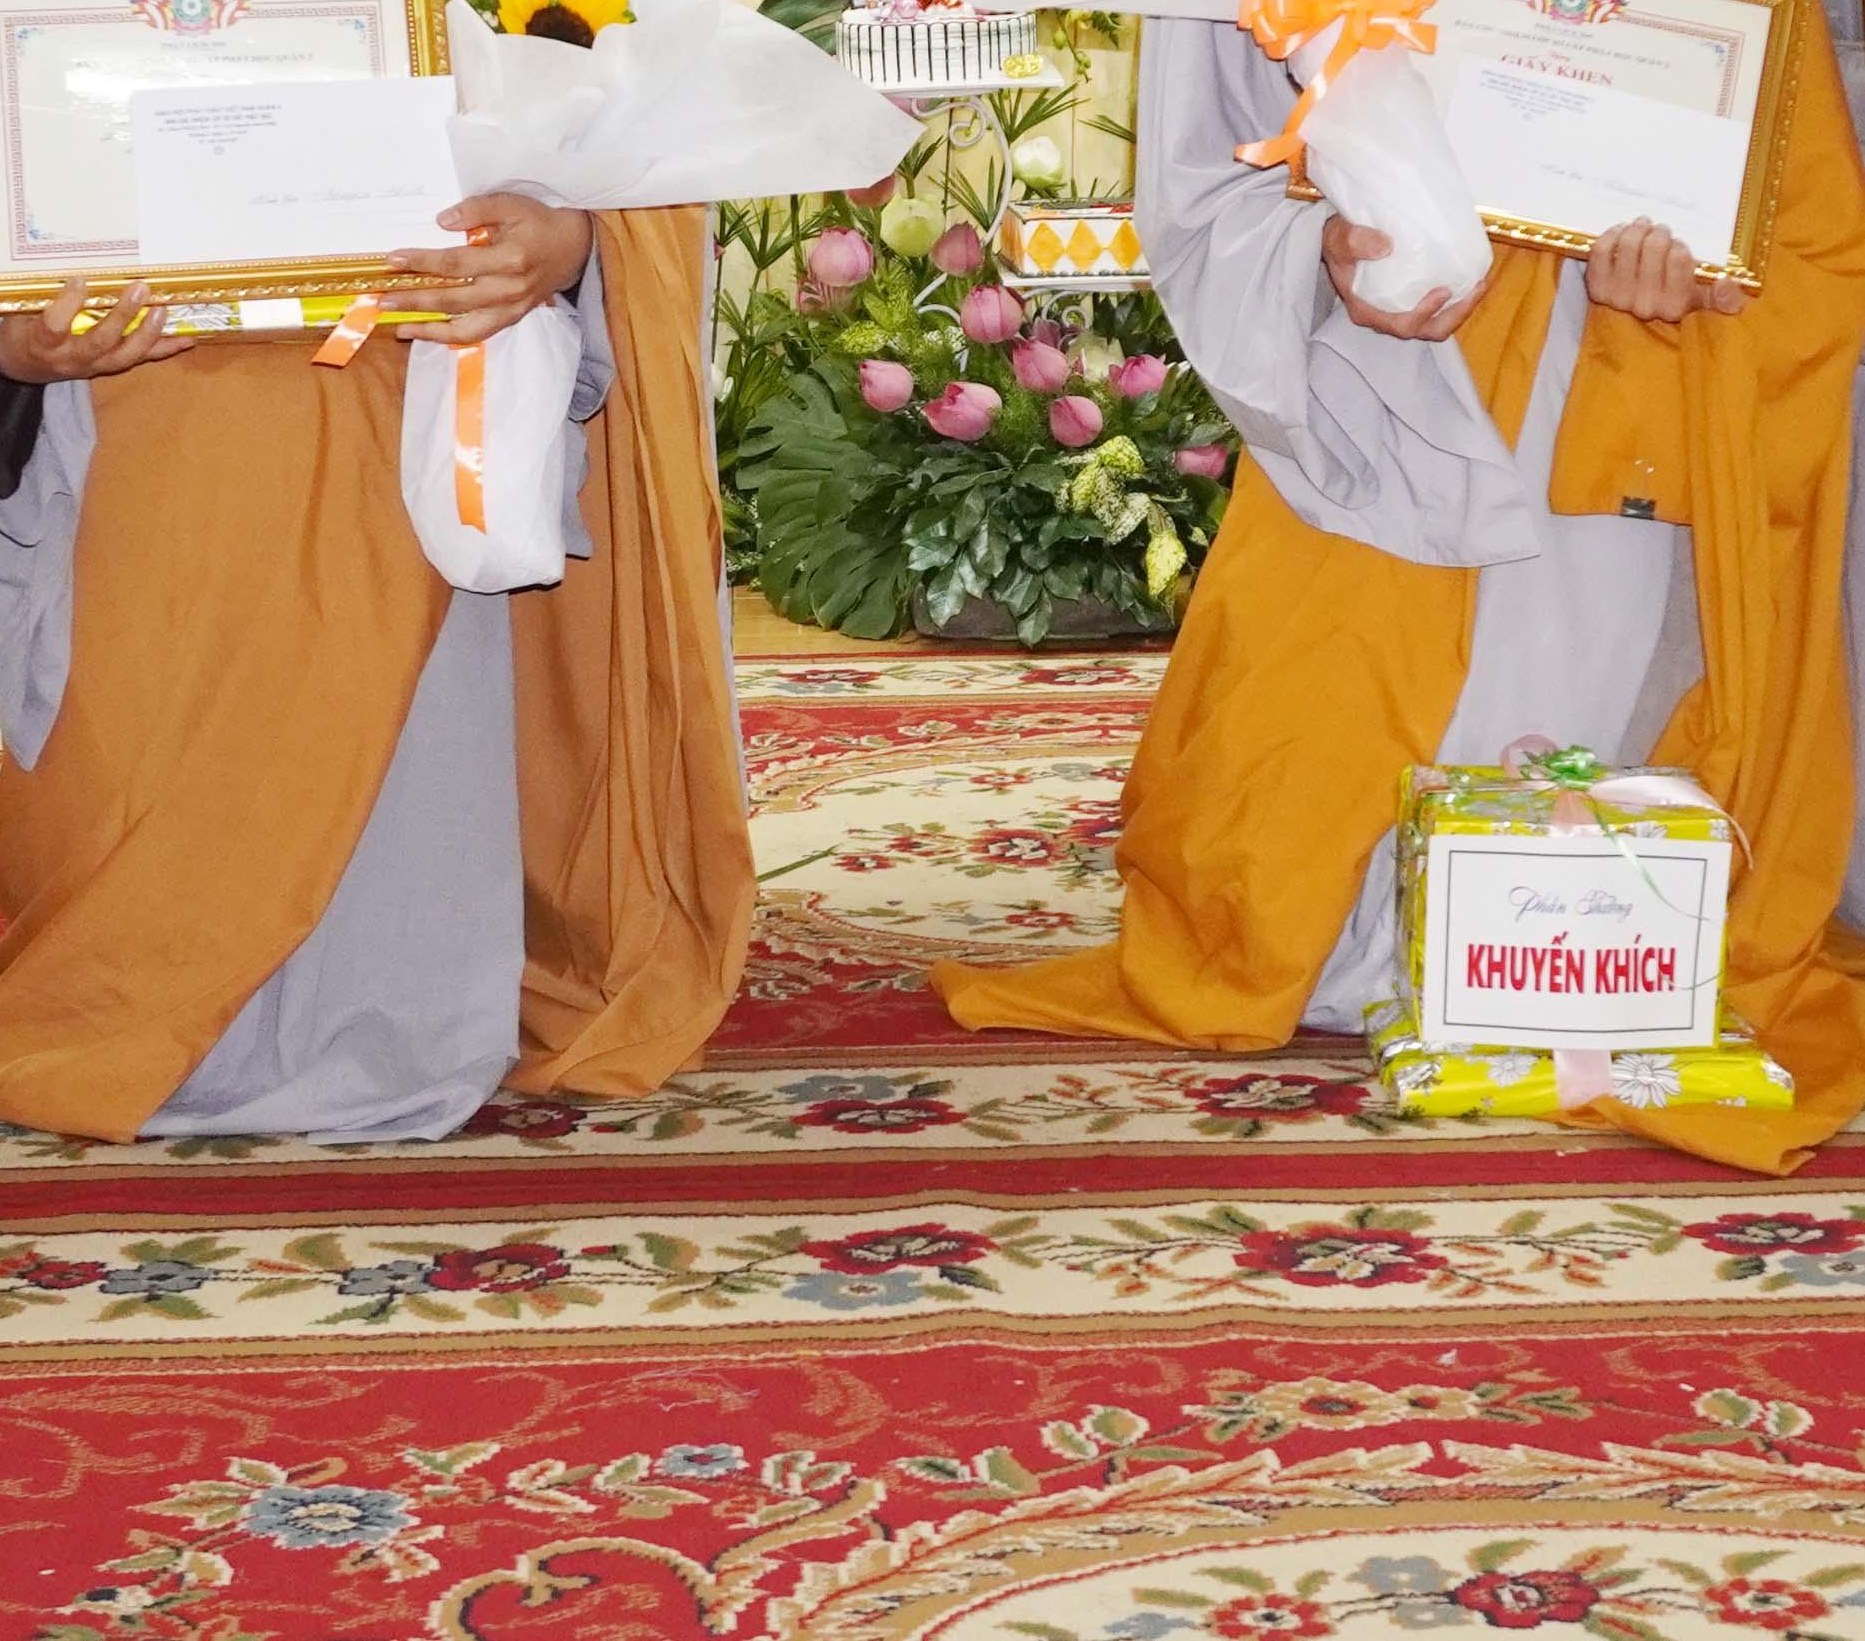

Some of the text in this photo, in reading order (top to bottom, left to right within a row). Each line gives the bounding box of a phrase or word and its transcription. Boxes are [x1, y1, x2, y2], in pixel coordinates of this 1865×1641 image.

[1556, 64, 1615, 87] KHEN
[1466, 930, 1677, 994] KHUYẾN KHÍCH
